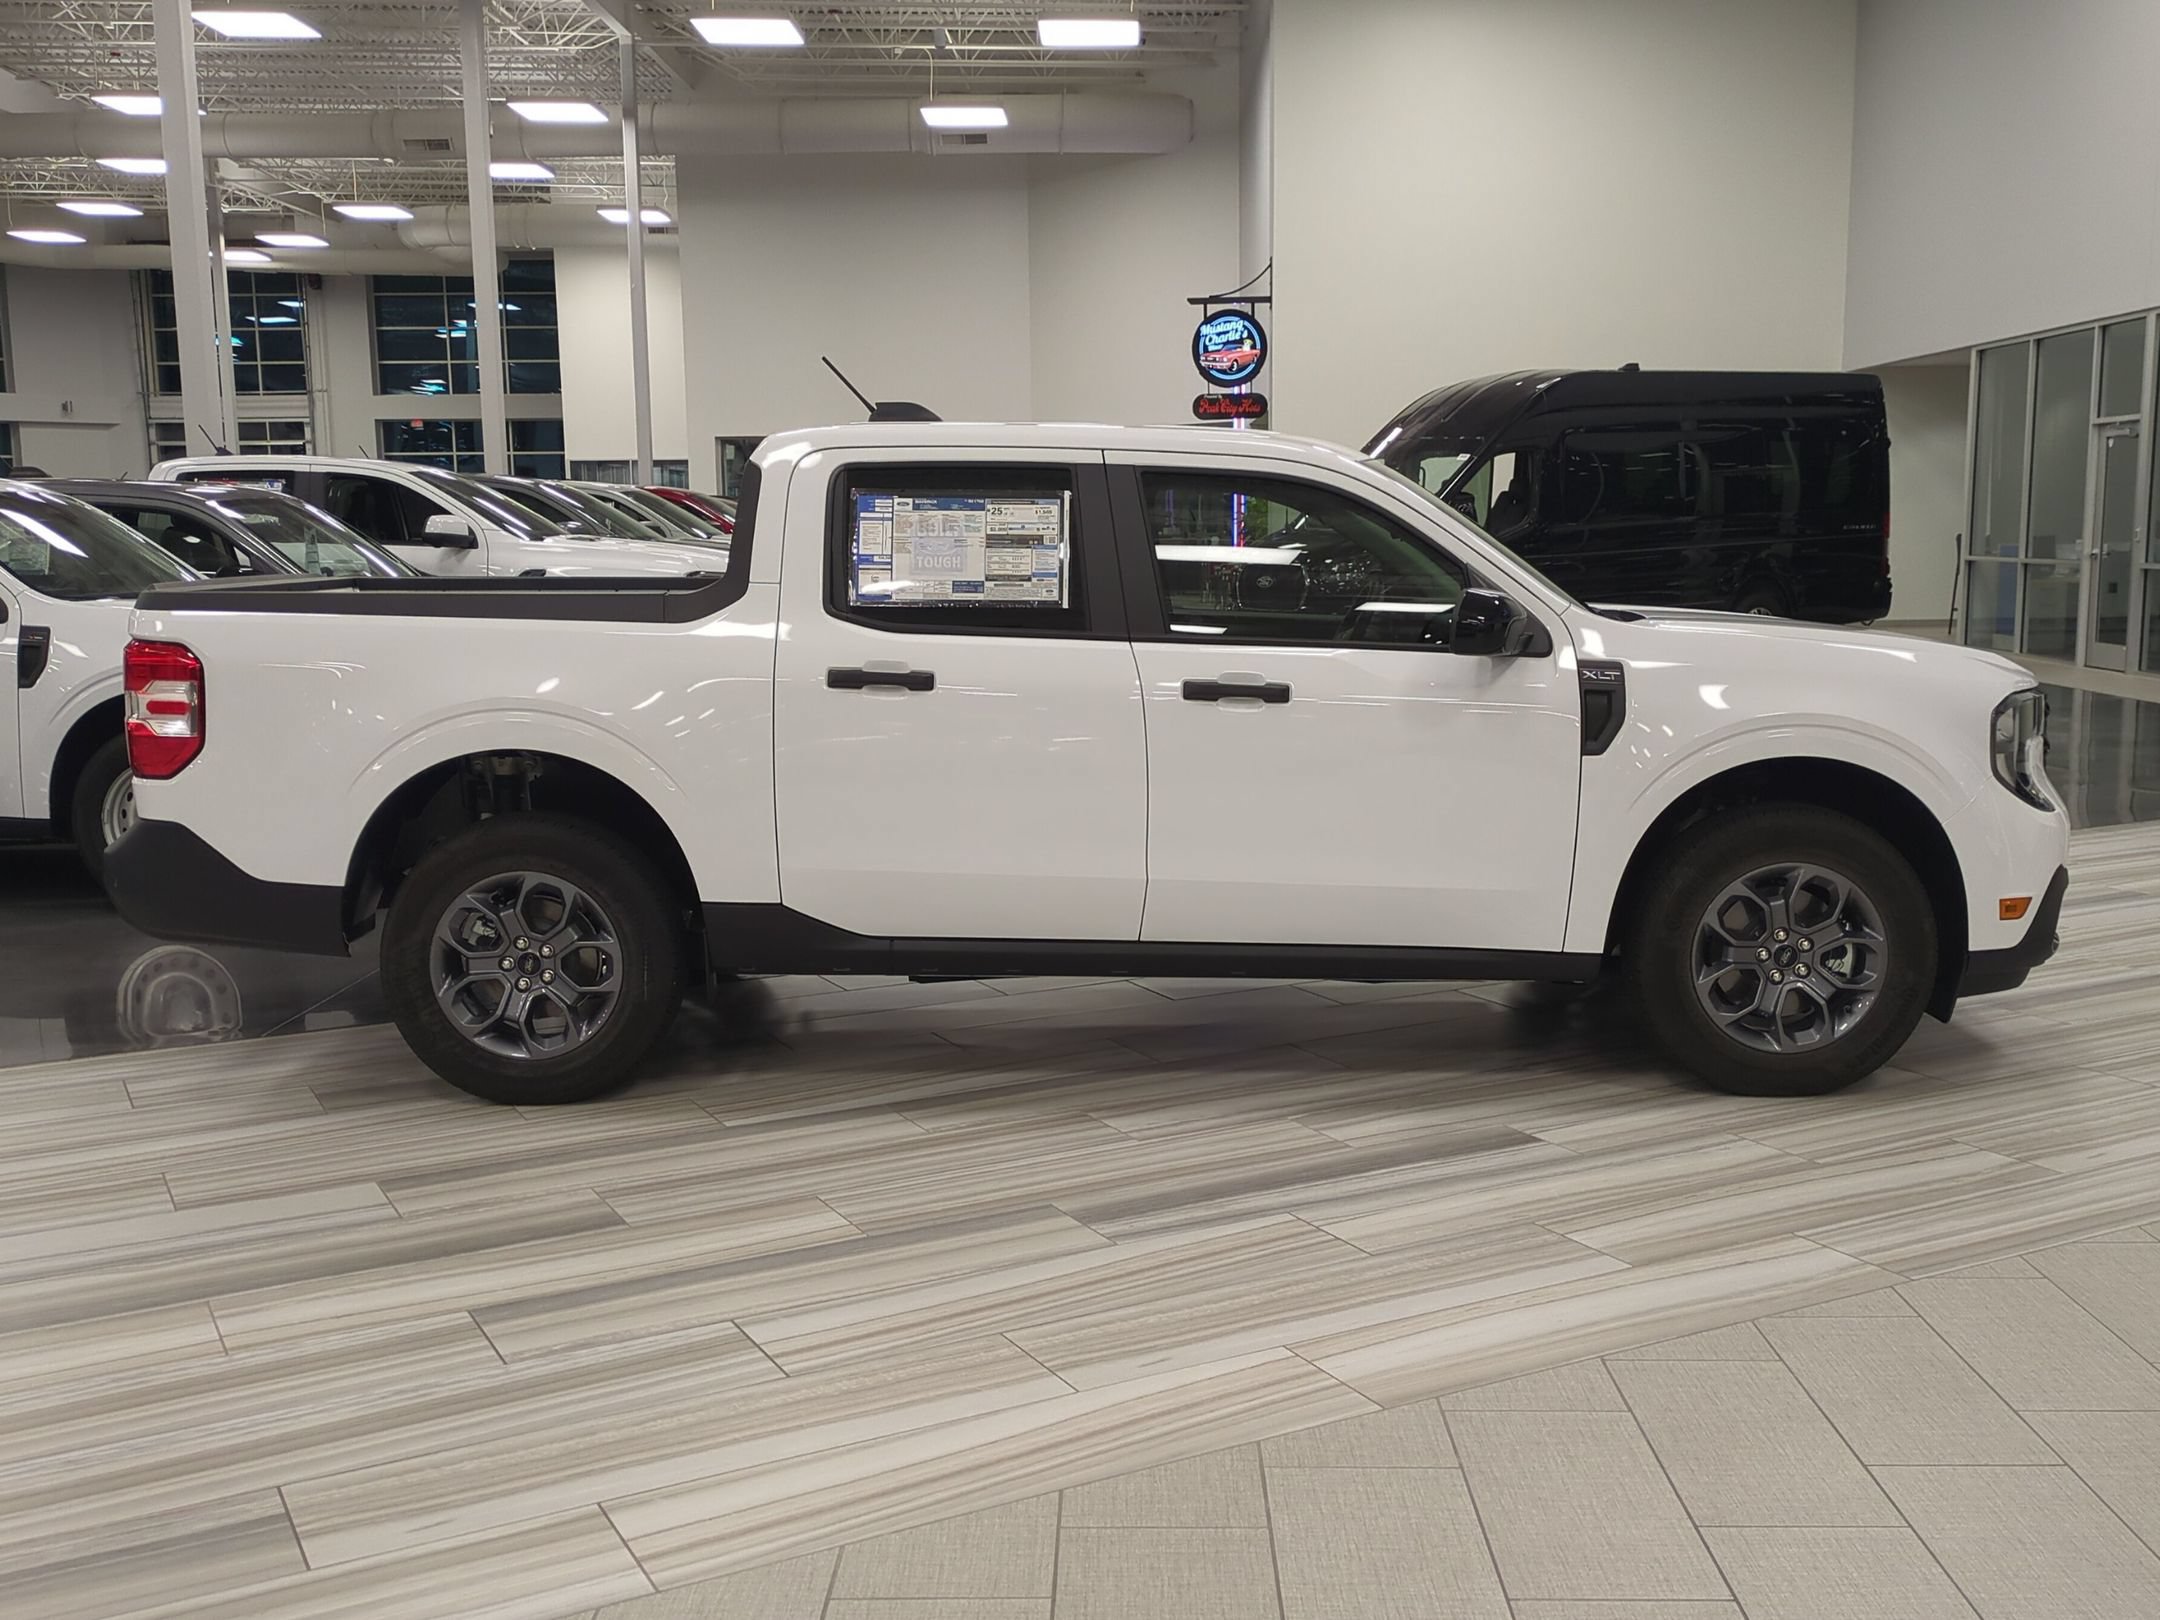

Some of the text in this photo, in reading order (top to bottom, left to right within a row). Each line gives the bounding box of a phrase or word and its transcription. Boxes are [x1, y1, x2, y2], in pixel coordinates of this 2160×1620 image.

[1200, 320, 1243, 335] Mustang
[1205, 329, 1248, 345] Charlie's
[991, 507, 1003, 515] 25
[916, 556, 961, 568] TOUGH
[1582, 670, 1621, 681] XLT
